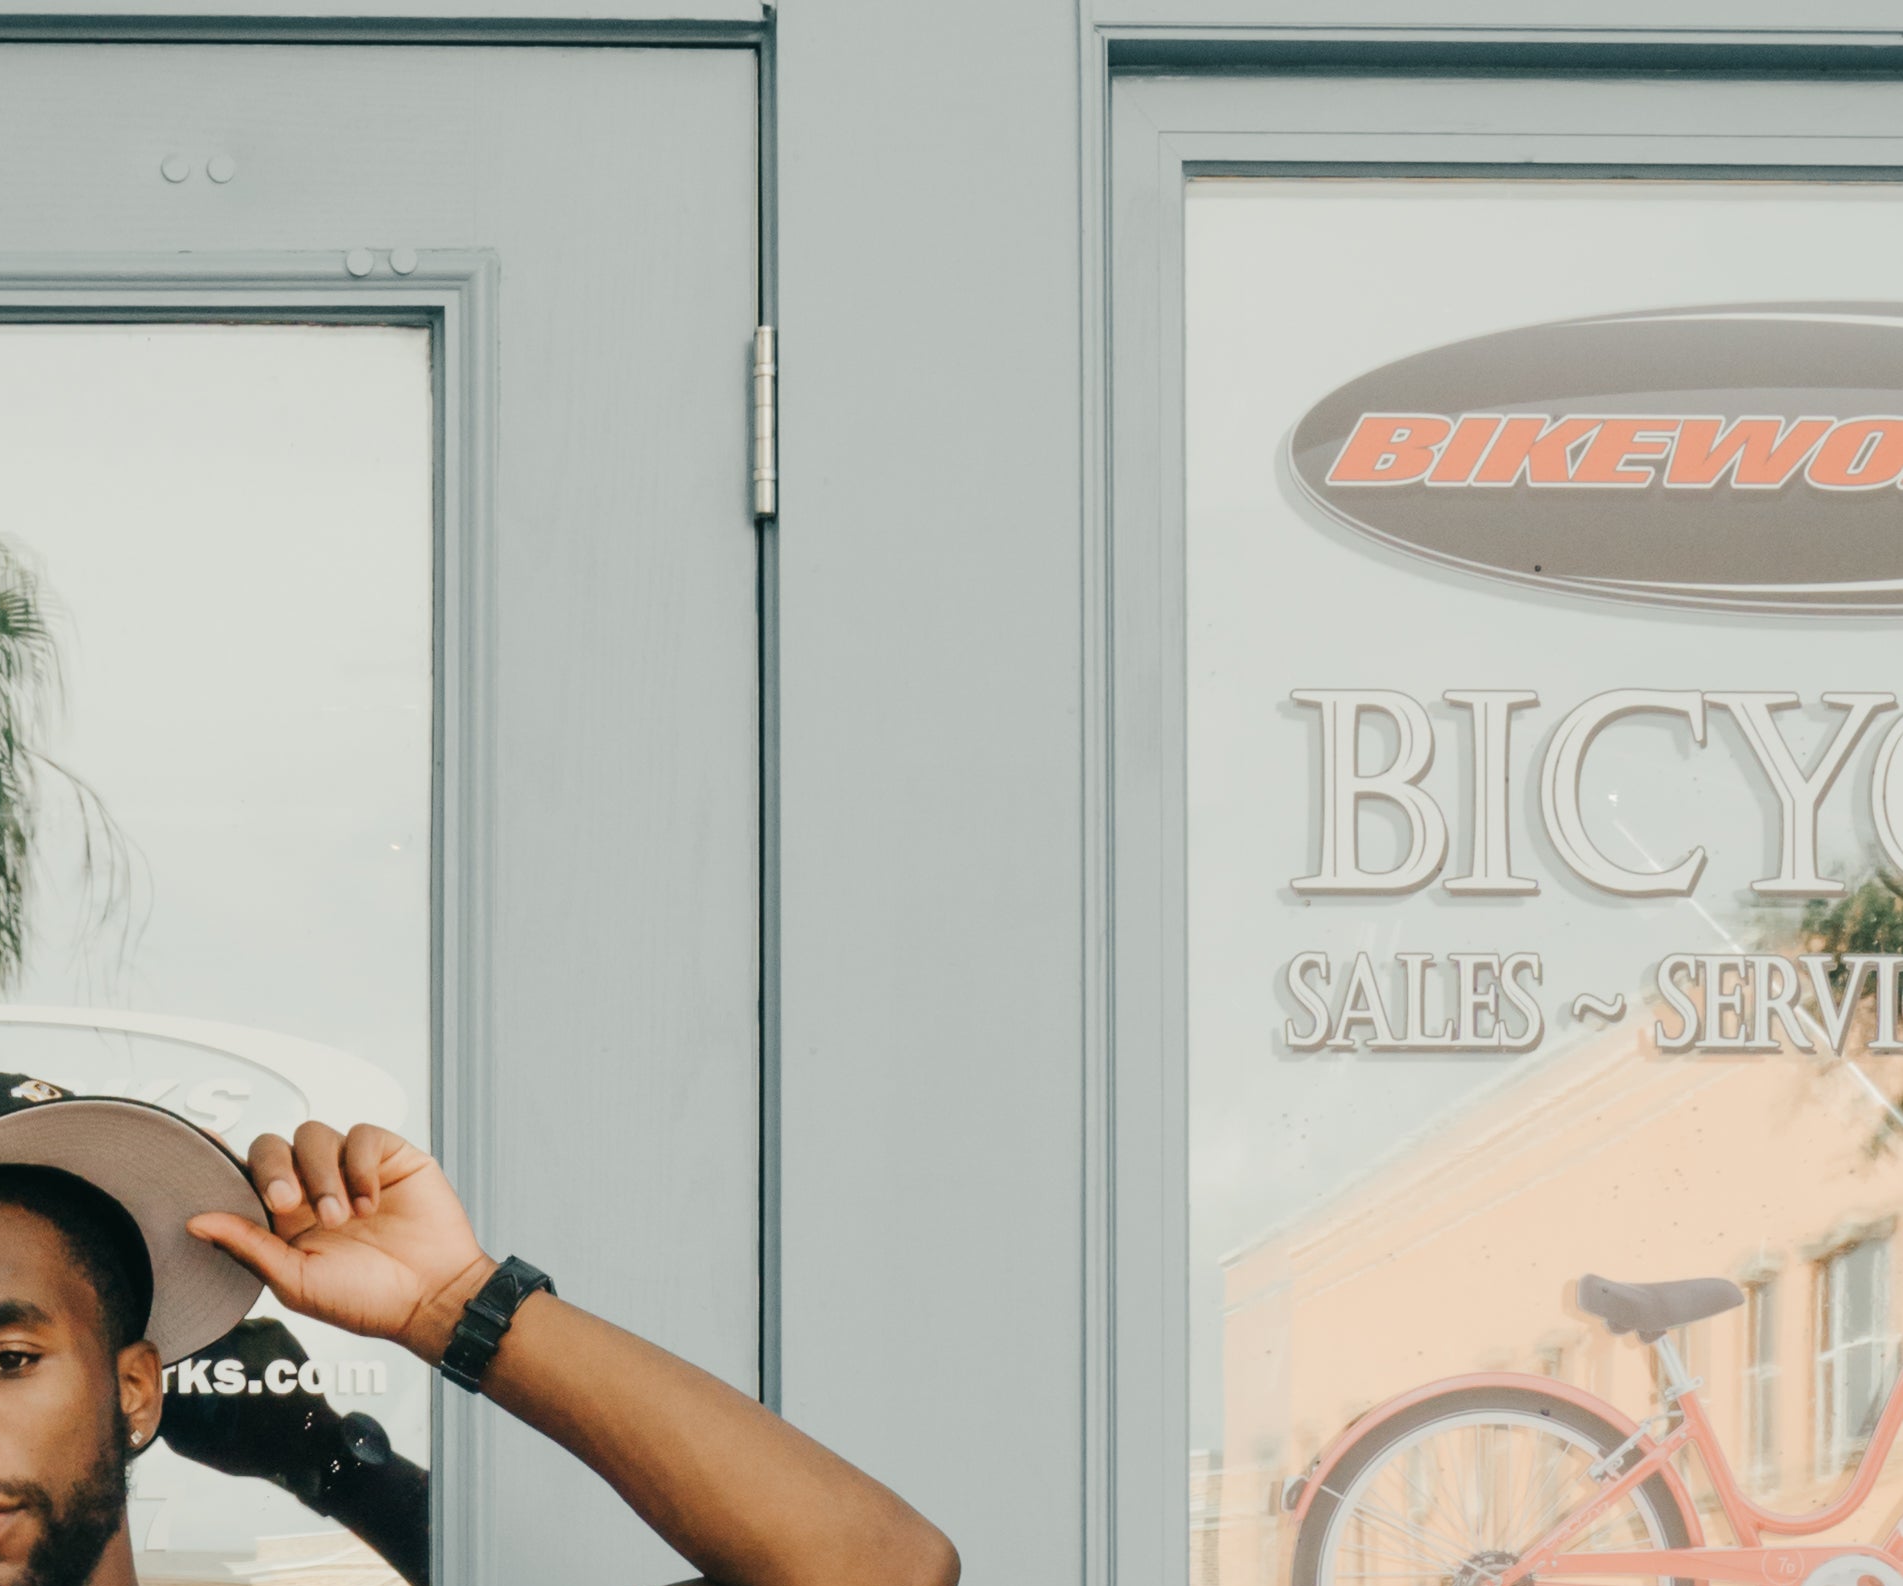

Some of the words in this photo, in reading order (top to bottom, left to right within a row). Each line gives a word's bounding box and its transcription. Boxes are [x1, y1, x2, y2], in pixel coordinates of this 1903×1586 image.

[1325, 412, 1903, 490] BIKEWO
[1289, 687, 1903, 894] BICY
[1285, 951, 1545, 1054] SALES
